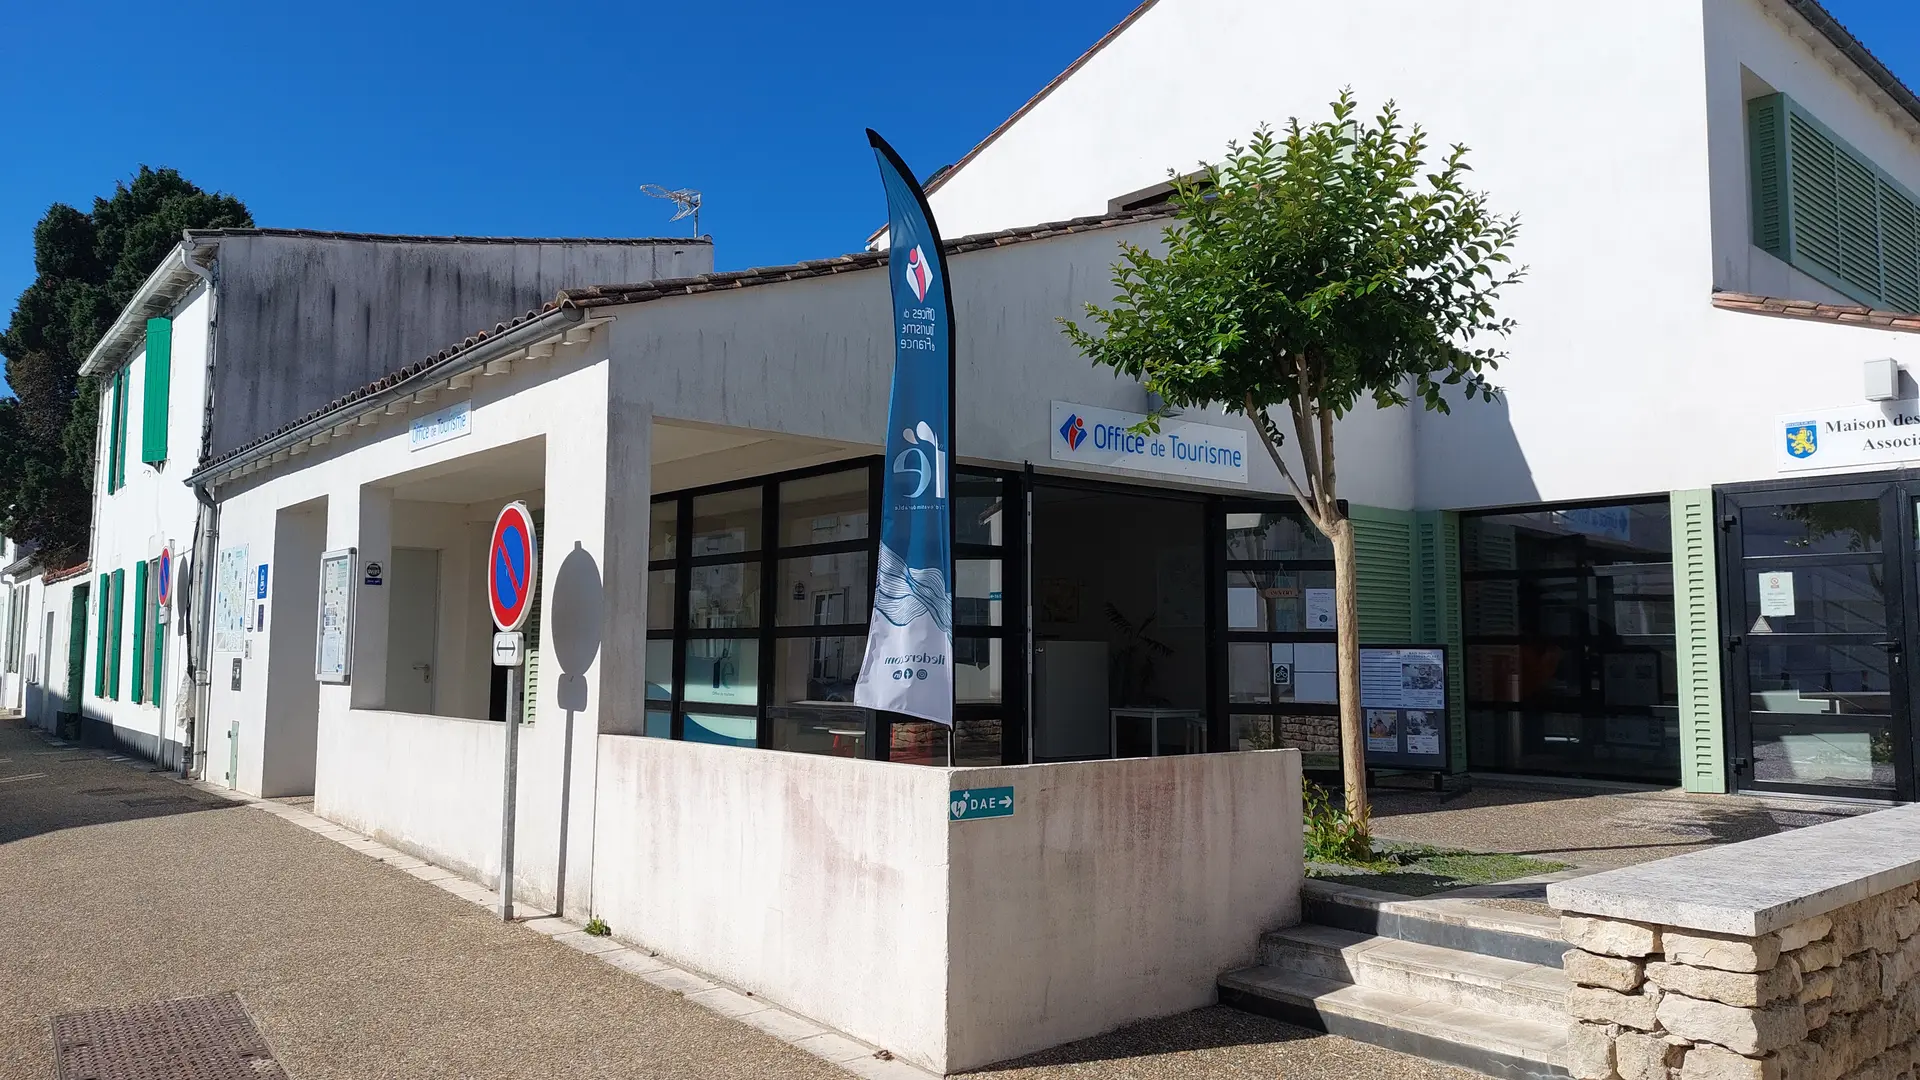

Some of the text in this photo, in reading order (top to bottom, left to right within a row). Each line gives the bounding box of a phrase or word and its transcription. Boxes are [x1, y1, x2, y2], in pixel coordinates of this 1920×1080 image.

[1825, 418, 1886, 434] Maison
[1893, 413, 1920, 427] des
[1094, 423, 1241, 467] Office de Tourisme
[1862, 433, 1920, 451] Associ
[970, 797, 996, 811] DAE
